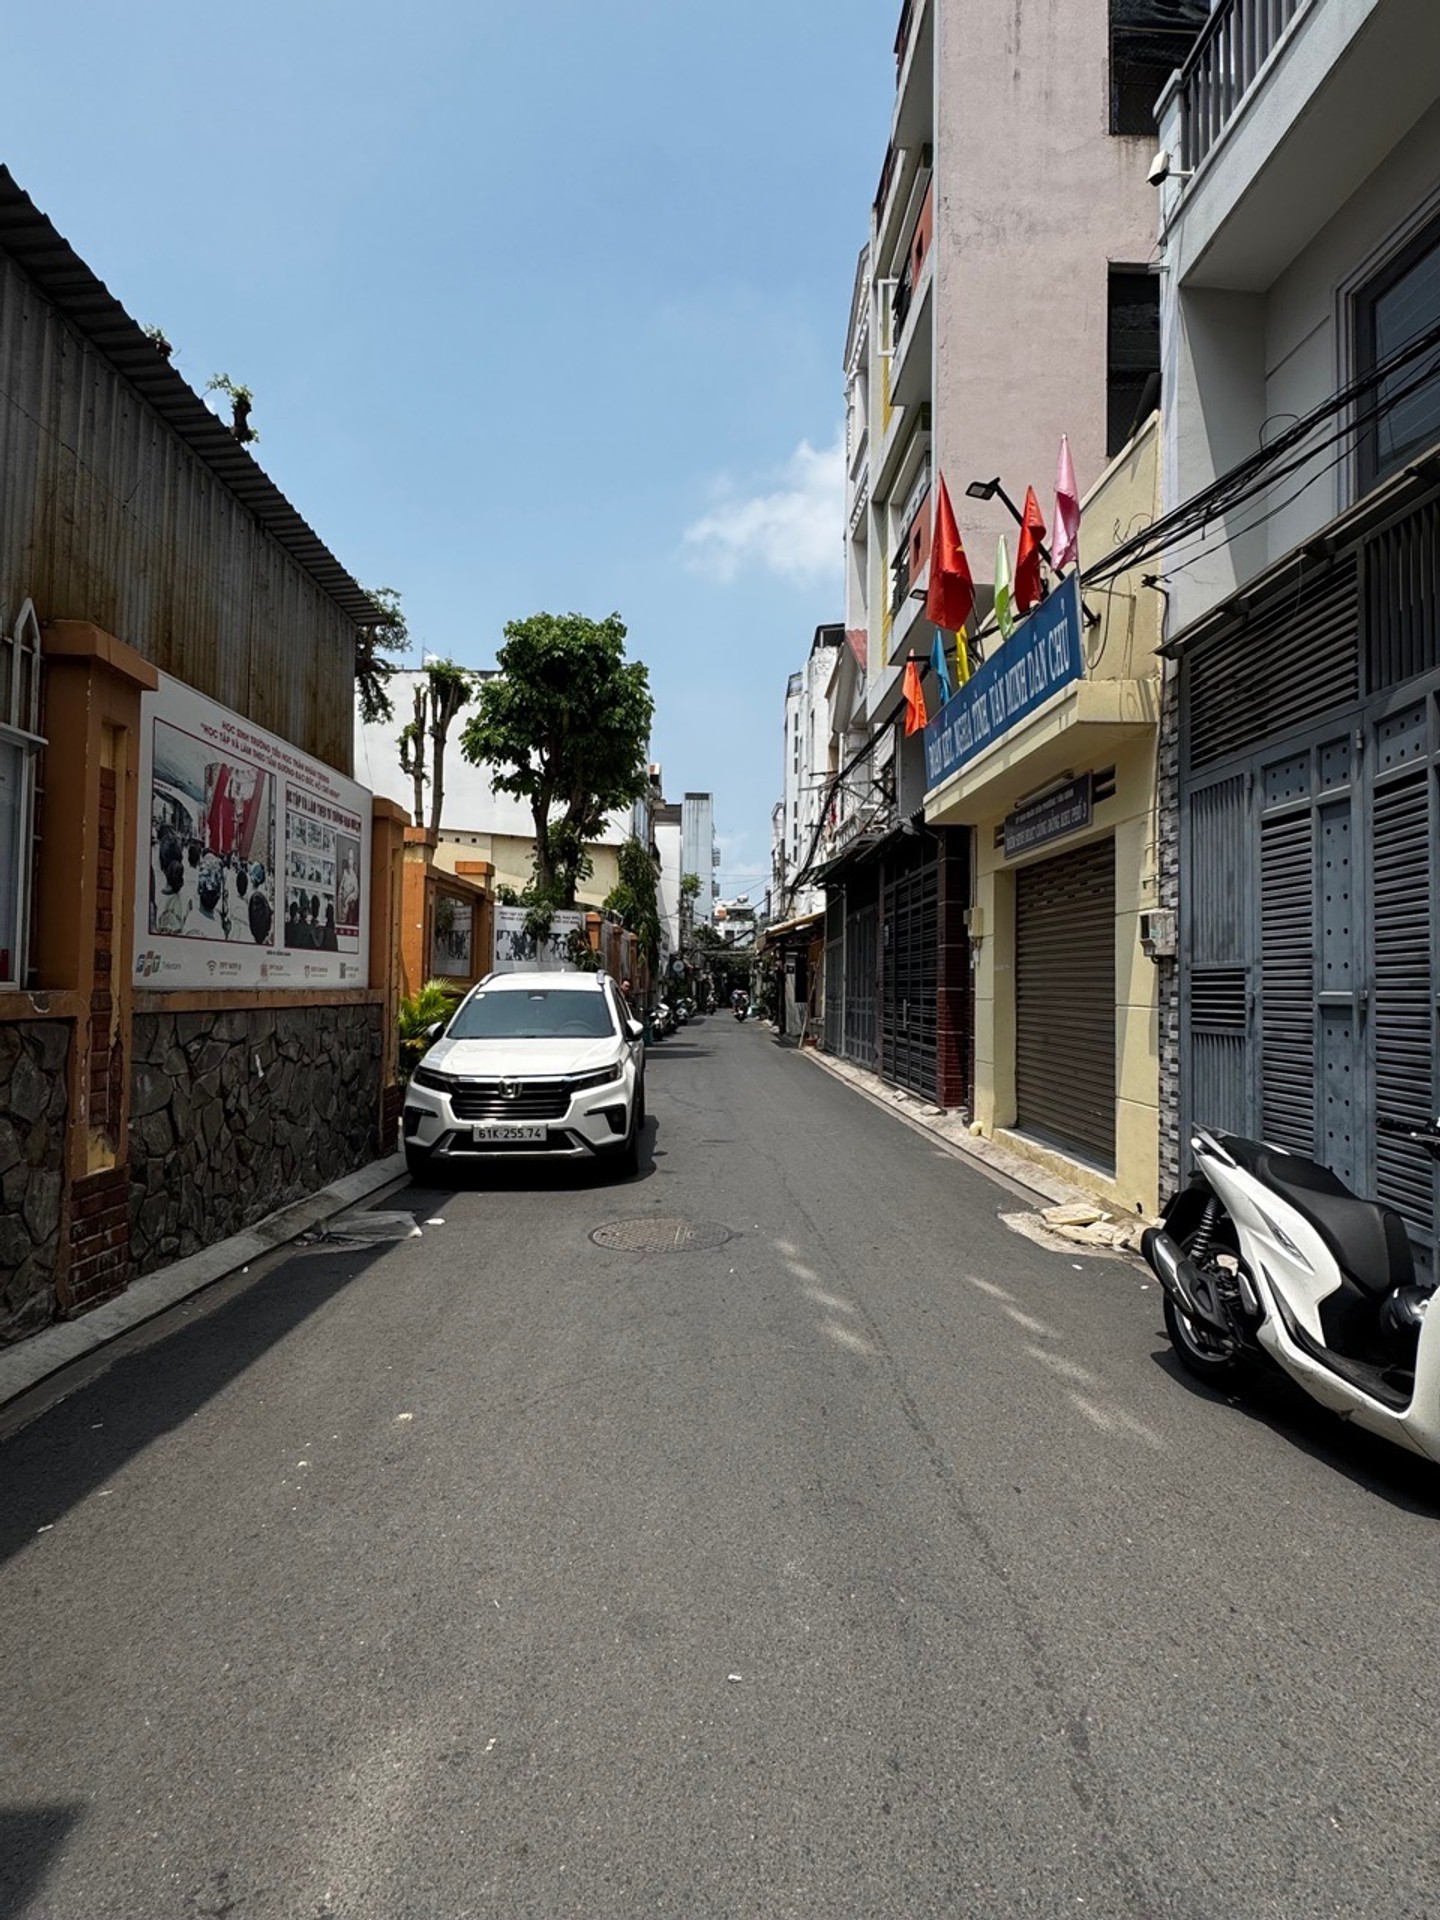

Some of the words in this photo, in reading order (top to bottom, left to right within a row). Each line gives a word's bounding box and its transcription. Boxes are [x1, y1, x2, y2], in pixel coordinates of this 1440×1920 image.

[1027, 631, 1048, 698] DÂN
[1048, 598, 1071, 681] CHỦ
[222, 720, 235, 735] HỌC
[136, 950, 162, 978] FPT
[478, 1127, 541, 1140] 61K-255.74
